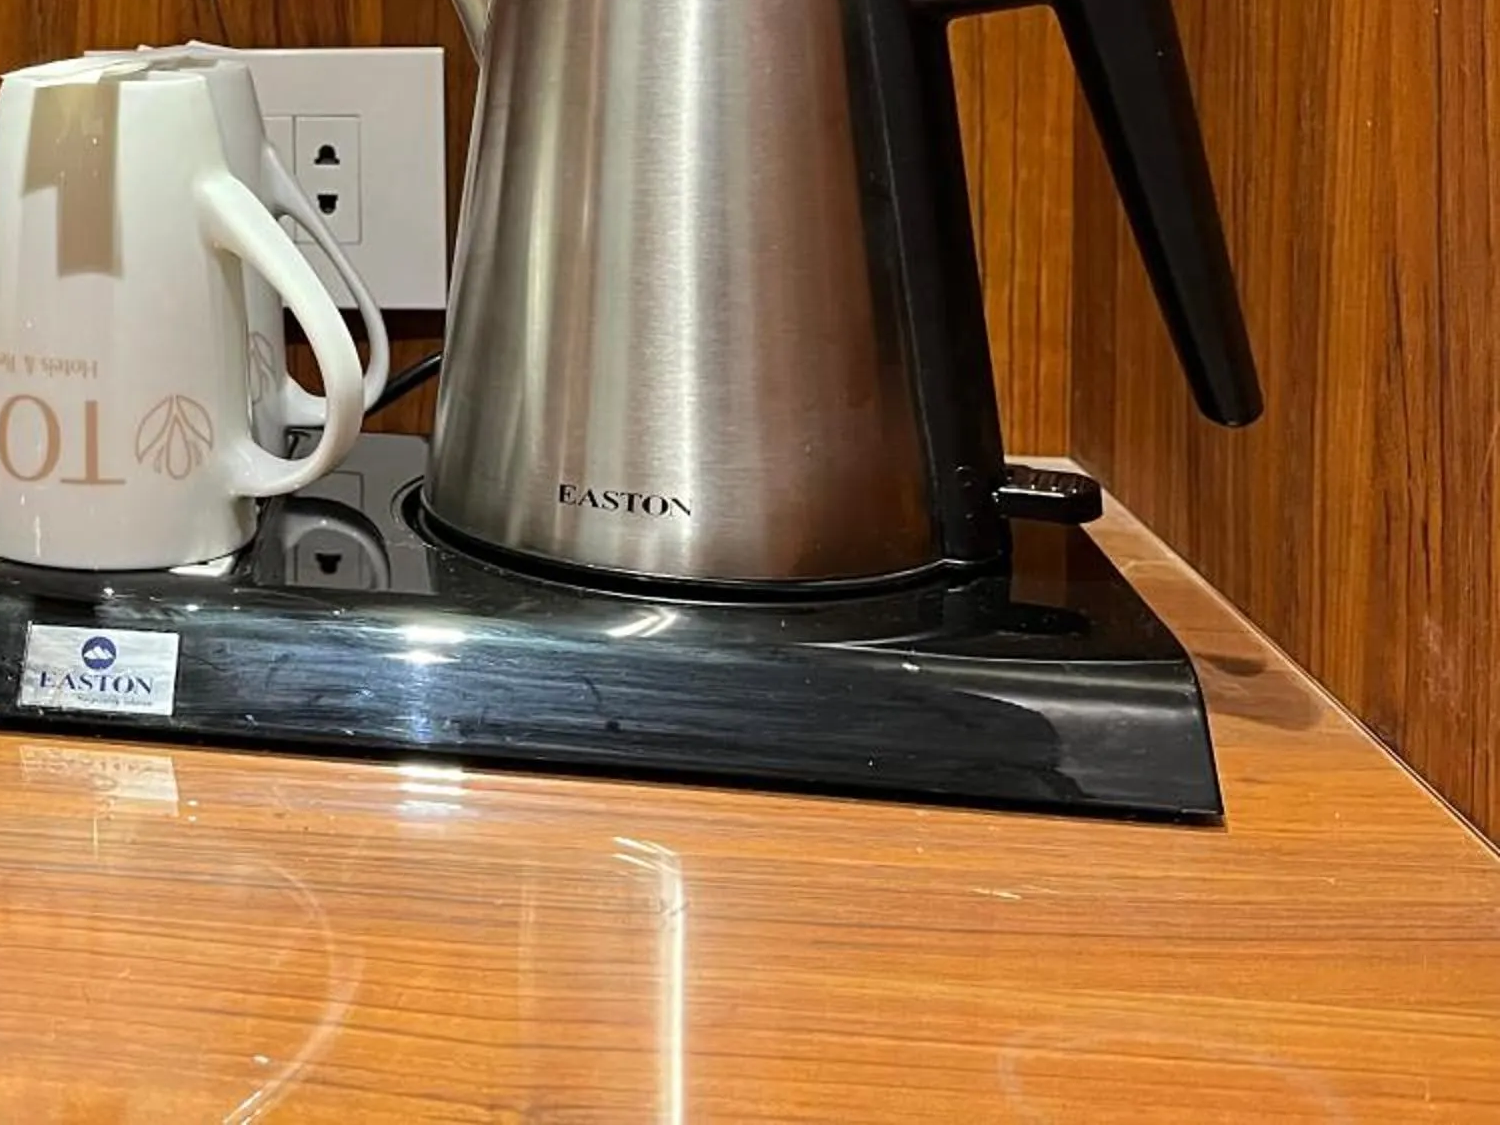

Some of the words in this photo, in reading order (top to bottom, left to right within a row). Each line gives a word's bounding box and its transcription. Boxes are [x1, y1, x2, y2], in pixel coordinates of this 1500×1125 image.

[41, 356, 99, 379] Hotels
[558, 483, 692, 517] EASTON
[39, 670, 154, 695] EASTON
